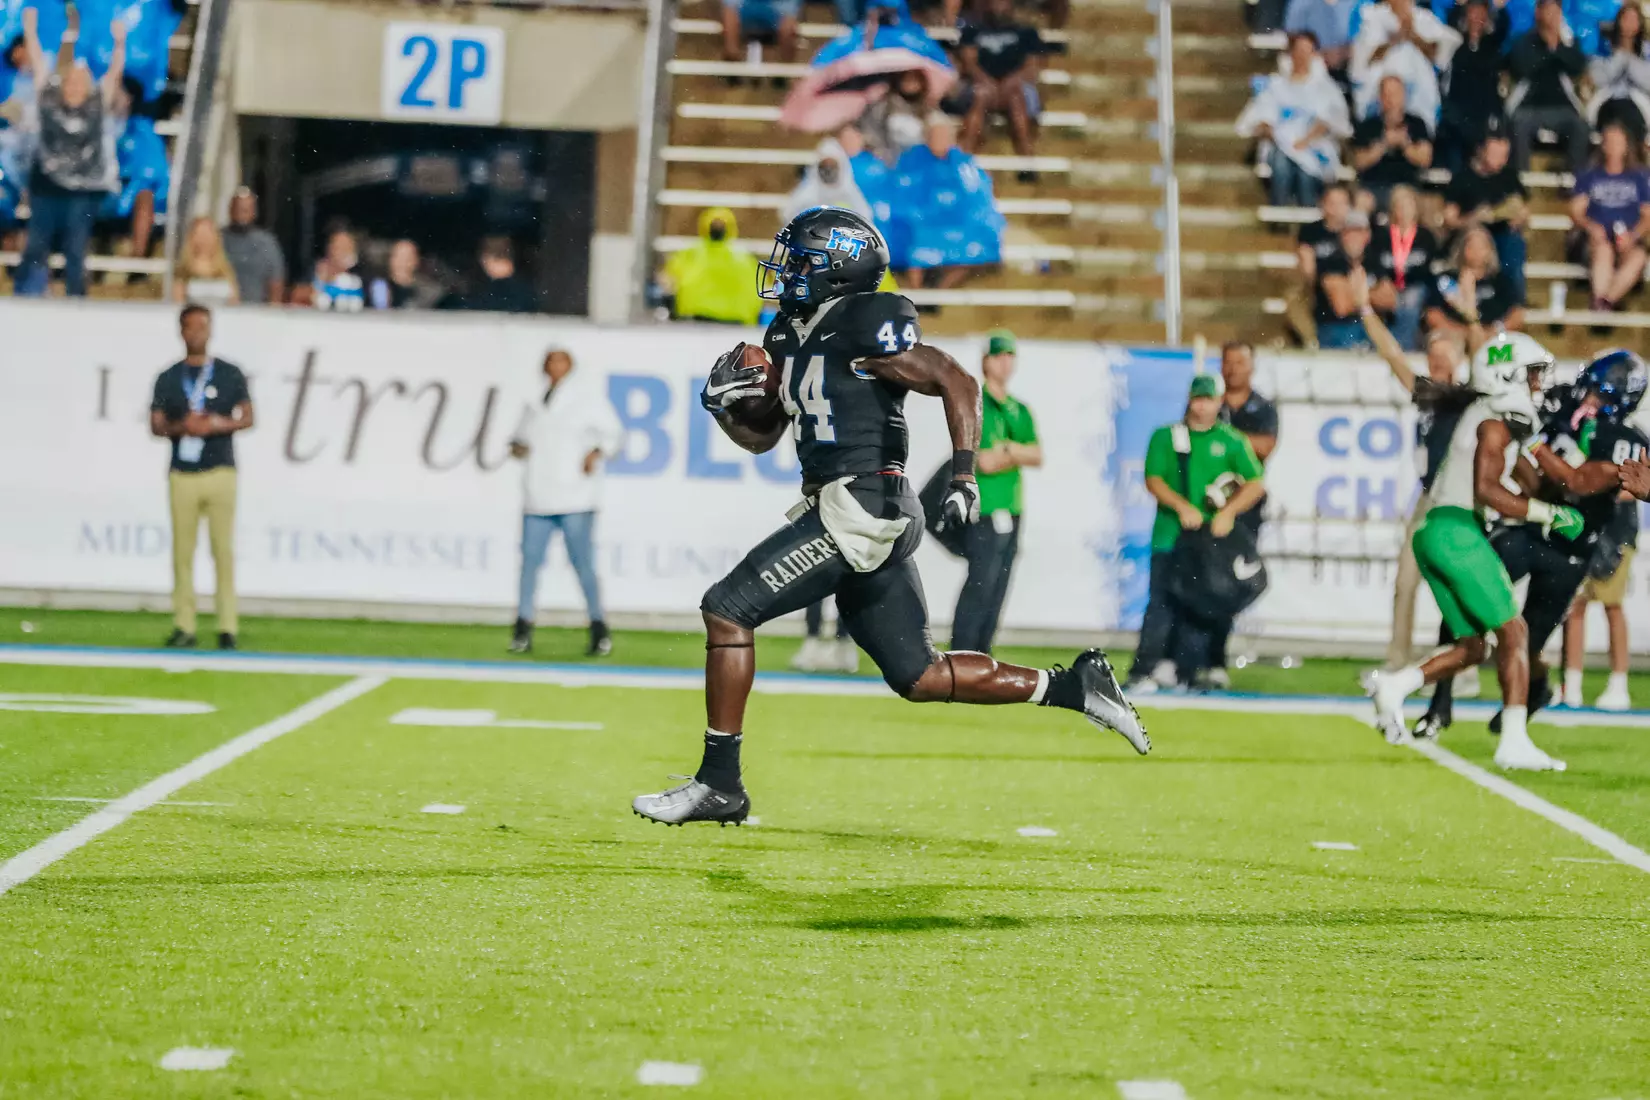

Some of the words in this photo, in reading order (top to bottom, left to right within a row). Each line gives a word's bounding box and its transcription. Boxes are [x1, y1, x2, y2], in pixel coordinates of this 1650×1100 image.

[400, 35, 487, 109] 2P
[876, 320, 918, 352] 44
[1487, 344, 1513, 365] M
[282, 348, 511, 473] tru
[1317, 415, 1406, 459] CO
[78, 519, 170, 556] MID
[266, 524, 489, 572] TENNESSEE
